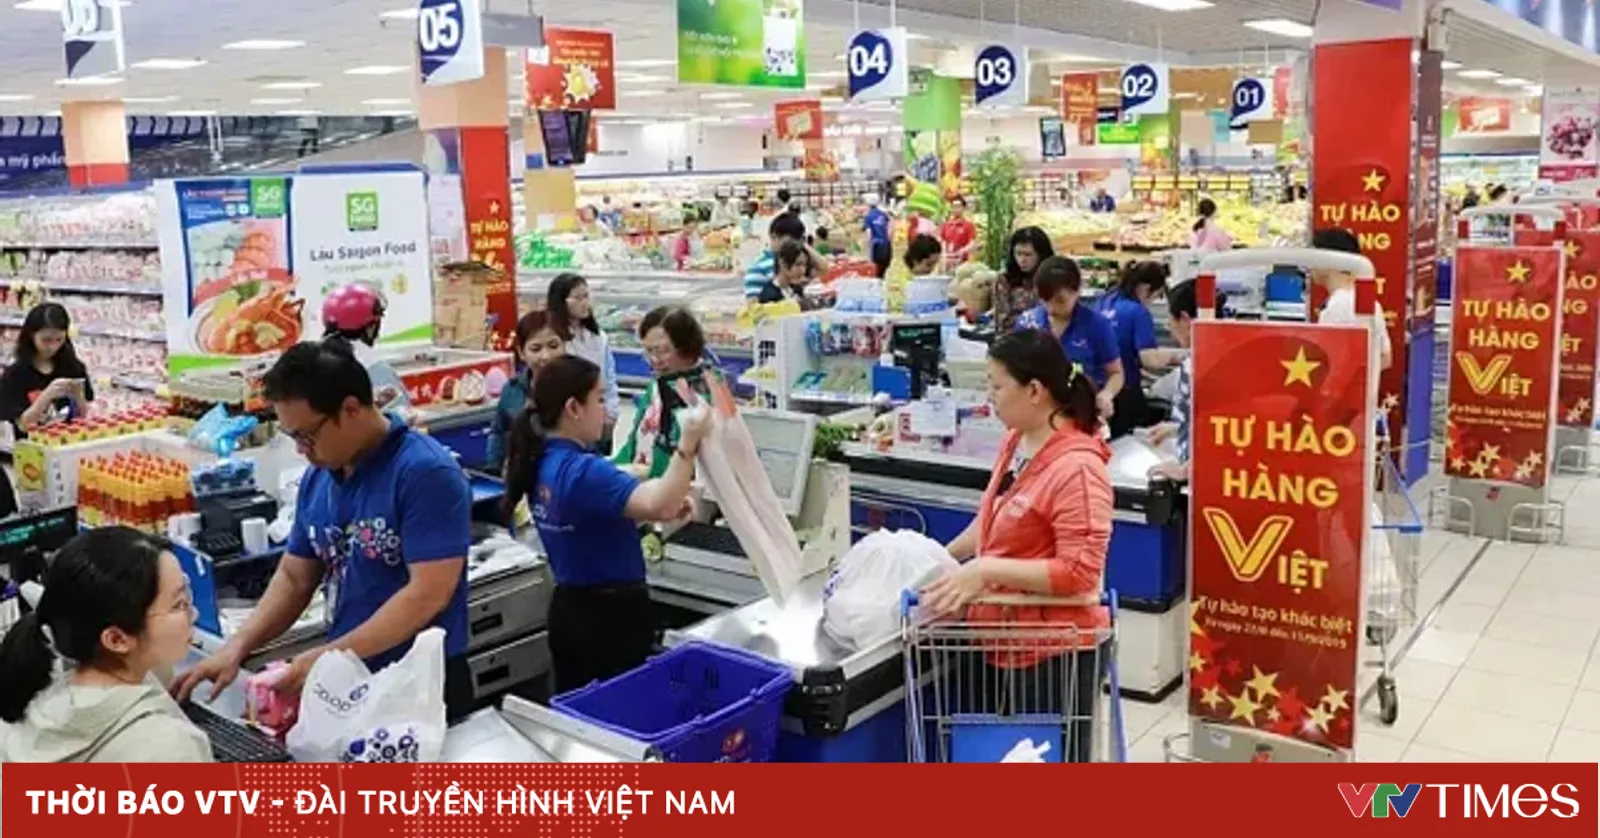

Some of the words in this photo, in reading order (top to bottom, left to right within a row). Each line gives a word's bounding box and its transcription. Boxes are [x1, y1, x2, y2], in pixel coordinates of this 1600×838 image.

[420, 3, 460, 52] 05
[849, 44, 889, 77] 04
[976, 57, 1011, 87] 03
[1123, 74, 1154, 98] 02
[1236, 88, 1261, 107] 01
[257, 185, 281, 202] SG
[350, 197, 375, 215] SG
[1320, 203, 1346, 227] TỰ
[1352, 200, 1401, 222] HÀO
[1566, 270, 1597, 290] ÀO
[1462, 299, 1490, 323] TỰ
[1495, 299, 1551, 321] HÀO
[1469, 326, 1540, 350] HÀNG
[1455, 351, 1533, 399] VIỆT
[1210, 414, 1257, 456] TỰ
[1266, 413, 1357, 457] HÀO
[1223, 462, 1339, 508] HÀNG
[1203, 507, 1329, 594] VIỆT
[1252, 605, 1278, 623] tạo
[1280, 608, 1318, 628] khác
